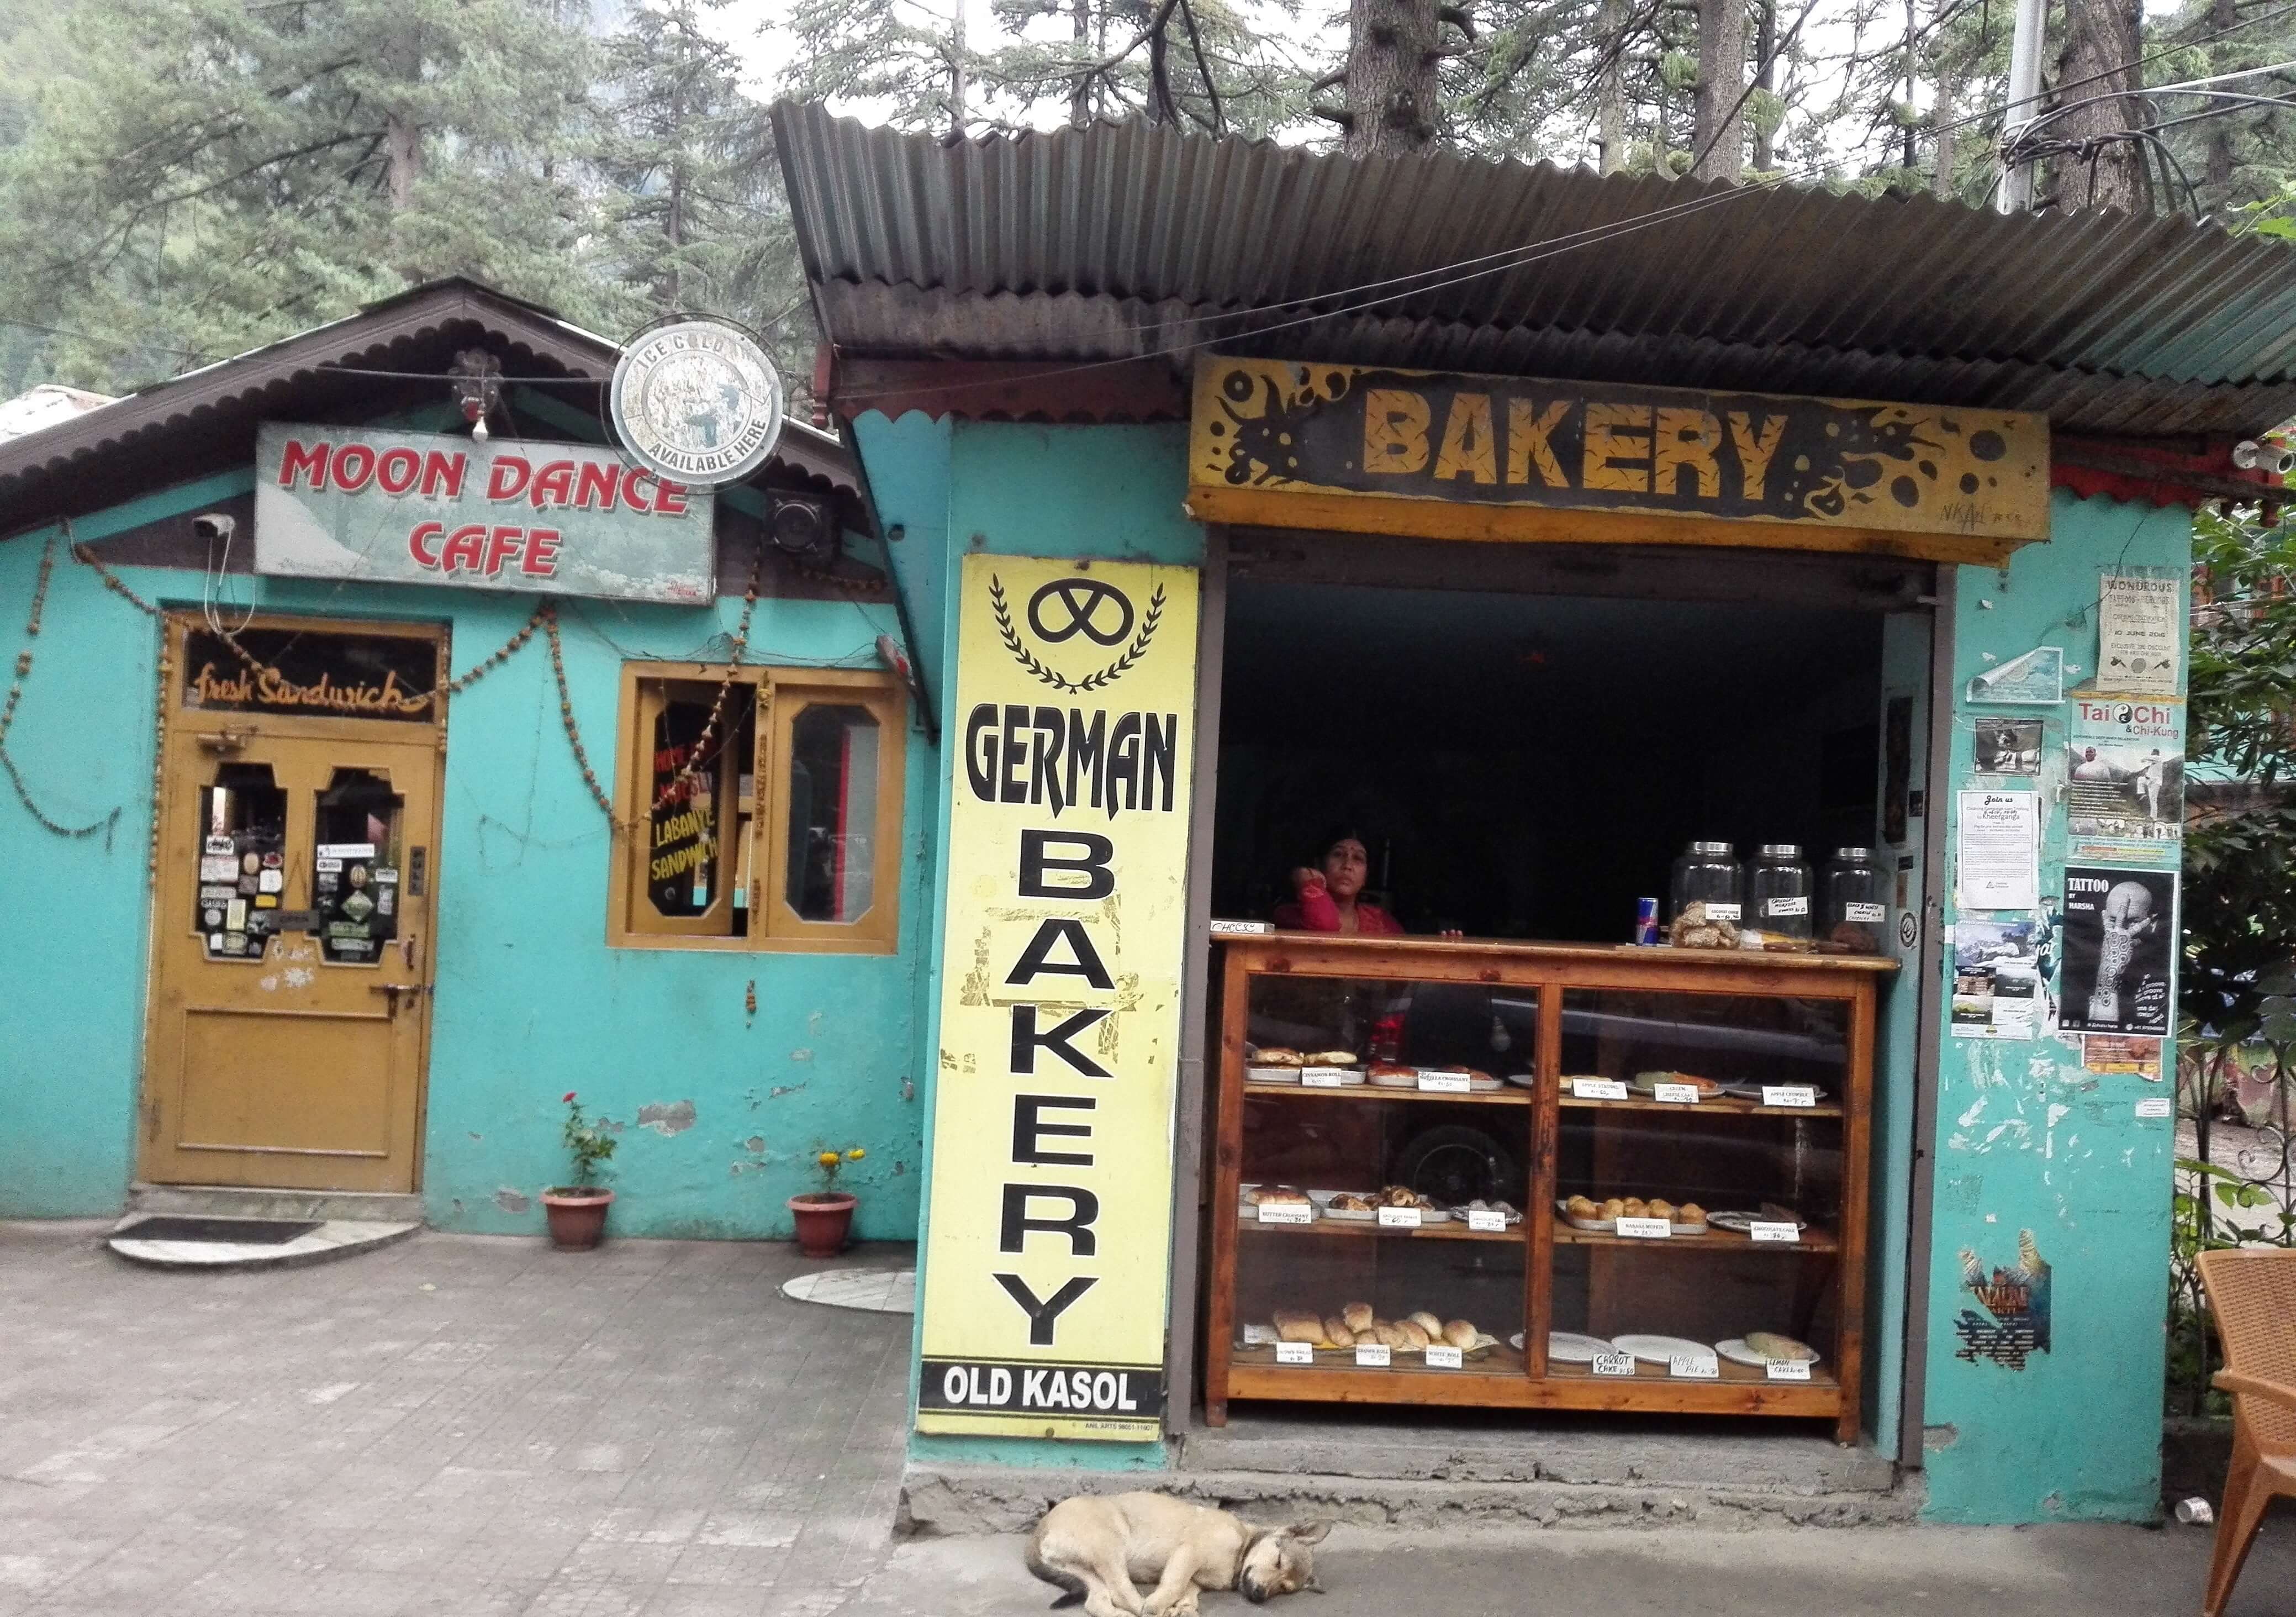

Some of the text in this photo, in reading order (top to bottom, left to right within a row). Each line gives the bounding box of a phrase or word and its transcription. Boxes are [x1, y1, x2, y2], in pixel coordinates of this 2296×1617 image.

[636, 334, 726, 369] ICE CLD
[648, 418, 767, 472] AVAILABLE HERE
[1364, 388, 1788, 500] BAKERY
[278, 440, 689, 517] MOON DANCE
[408, 521, 562, 576] CAFE
[194, 662, 253, 703] fresh
[2078, 703, 2170, 724] Tai Chi
[2133, 725, 2179, 740] Chi-Kung
[966, 703, 1178, 821] GERMAN
[1984, 796, 2003, 805] Join
[652, 837, 718, 881] SANDWICH
[2068, 877, 2109, 892] TATTOO
[991, 829, 1116, 1345] BAKERY
[1597, 1354, 1631, 1365] CARROT
[1598, 1365, 1618, 1373] CAKE
[1672, 1356, 1694, 1366] APPLE
[1685, 1365, 1699, 1373] PIE
[943, 1366, 1137, 1411] OLD KASOL
